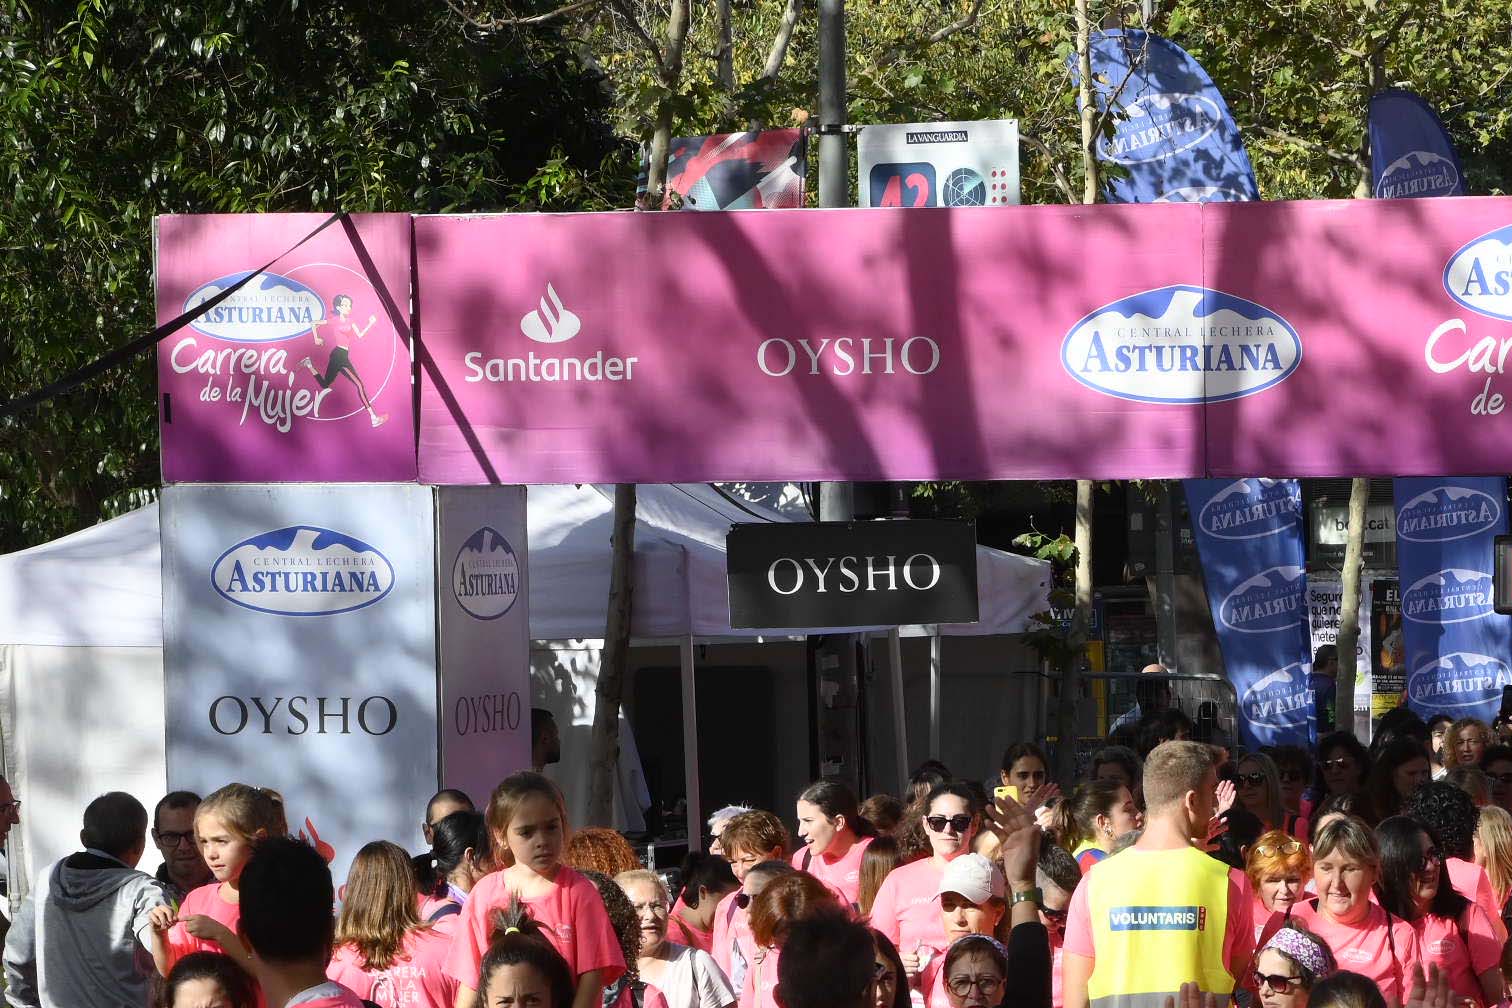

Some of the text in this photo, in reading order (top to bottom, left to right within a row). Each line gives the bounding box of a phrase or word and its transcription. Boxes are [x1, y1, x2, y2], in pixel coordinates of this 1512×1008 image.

[194, 297, 314, 324] ASTURIANA
[1116, 324, 1275, 338] CENTRAL LECHERA
[171, 337, 288, 375] Carrera
[464, 351, 639, 383] Santander
[756, 335, 940, 377] OYSHO
[1080, 329, 1283, 373] ASTURIANA
[199, 371, 333, 433] de la Mujer
[1470, 376, 1506, 416] de
[226, 558, 382, 594] ASTURIANA
[253, 556, 376, 567] CENTRAL LECHERA
[457, 562, 516, 597] ASTURIANA
[766, 553, 941, 596] OYSHO
[208, 695, 399, 737] OYSHO
[454, 691, 521, 737] OYSHO
[1111, 912, 1196, 926] VOLUNTARIS
